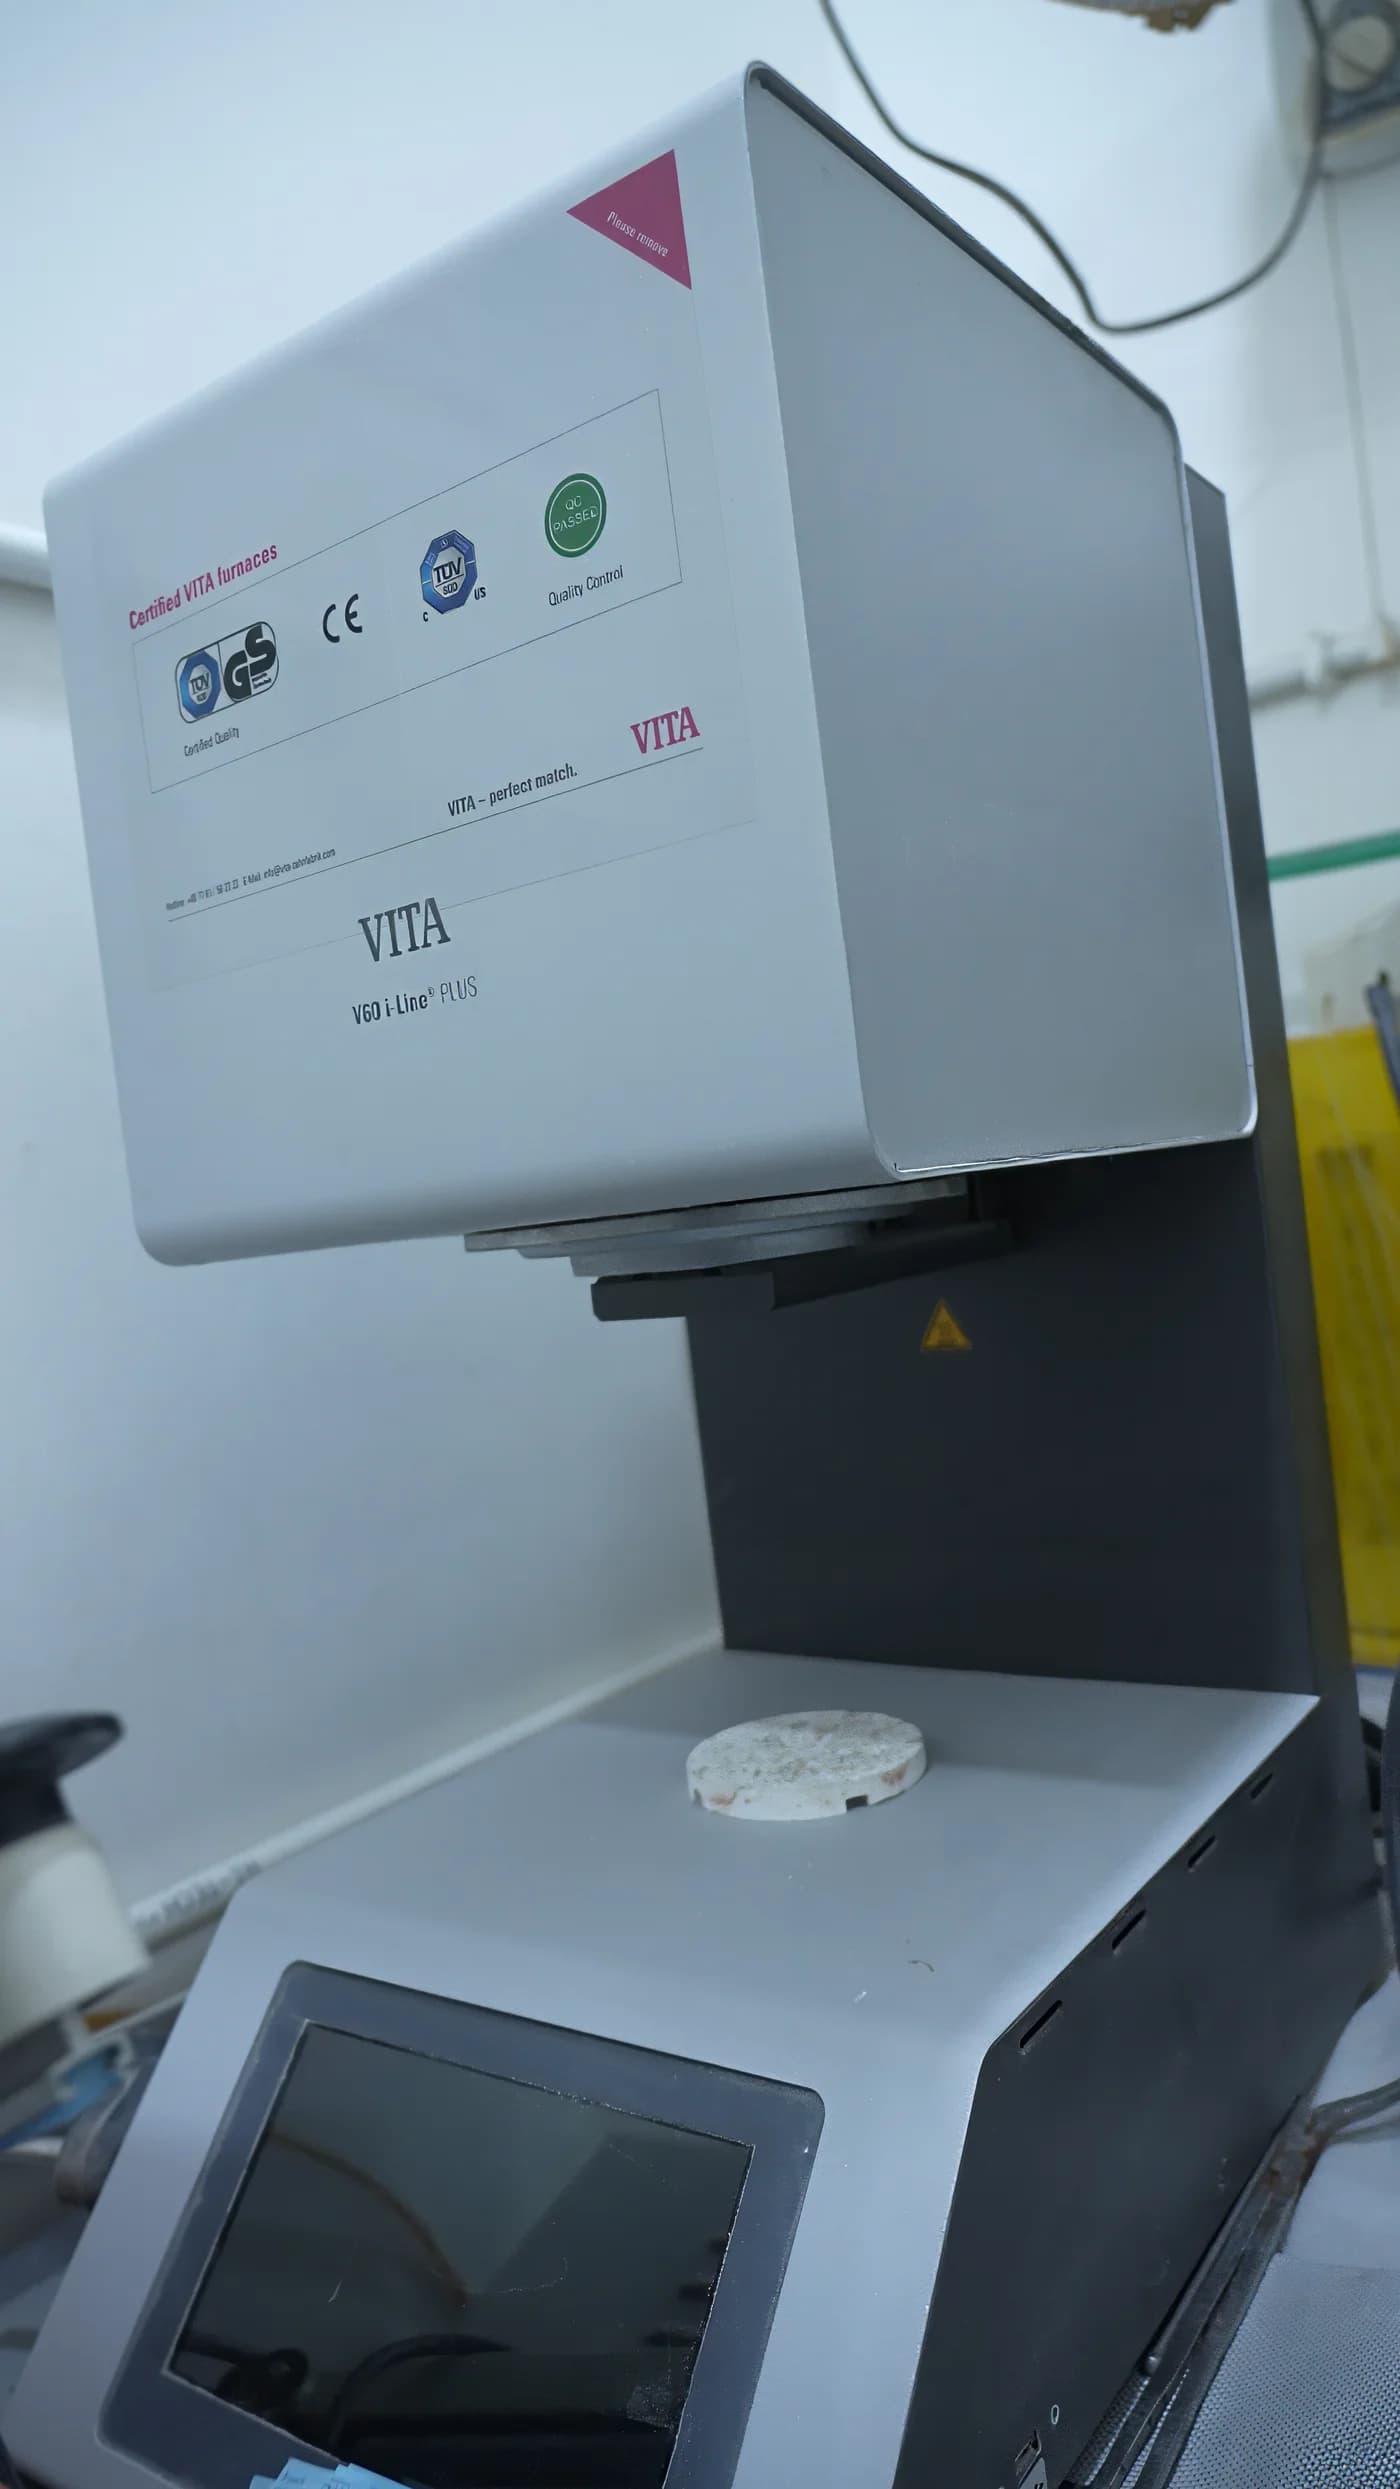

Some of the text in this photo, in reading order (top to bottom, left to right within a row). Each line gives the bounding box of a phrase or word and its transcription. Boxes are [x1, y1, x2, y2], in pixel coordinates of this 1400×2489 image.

[607, 211, 669, 257] Please remove
[553, 505, 599, 533] PASSED
[565, 495, 583, 510] QC
[129, 543, 278, 630] Certified VITA furnaces
[548, 564, 624, 607] Quality Control
[630, 706, 701, 754] VITA
[447, 794, 476, 817] VITA
[489, 777, 533, 807] perfect
[535, 762, 578, 790] match.
[358, 897, 451, 964] VITA
[352, 1000, 381, 1026] V60
[440, 975, 479, 1004] PLUS
